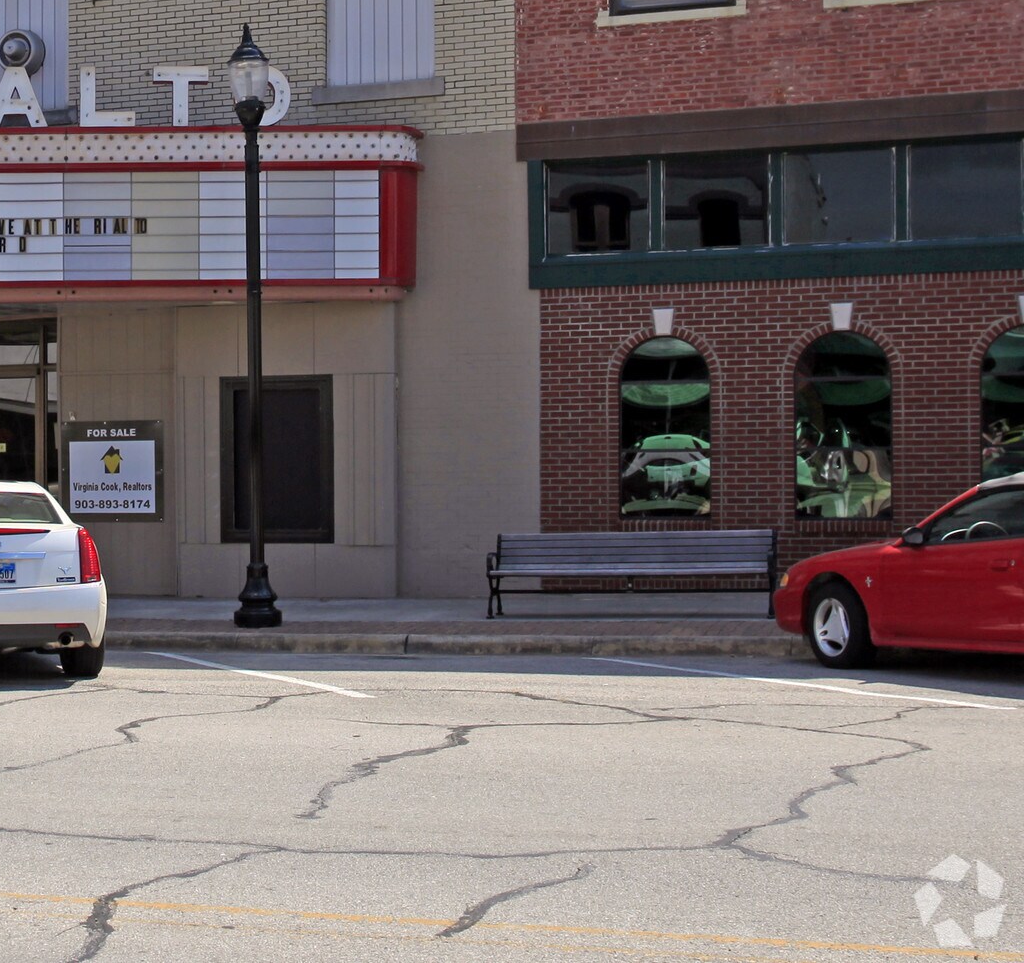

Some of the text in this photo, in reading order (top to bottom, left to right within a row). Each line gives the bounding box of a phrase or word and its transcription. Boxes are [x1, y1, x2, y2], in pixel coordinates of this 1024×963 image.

[87, 428, 136, 437] FOR SALE
[73, 482, 152, 493] Virginia Cook, Realtors
[74, 500, 151, 509] 903-893-8174
